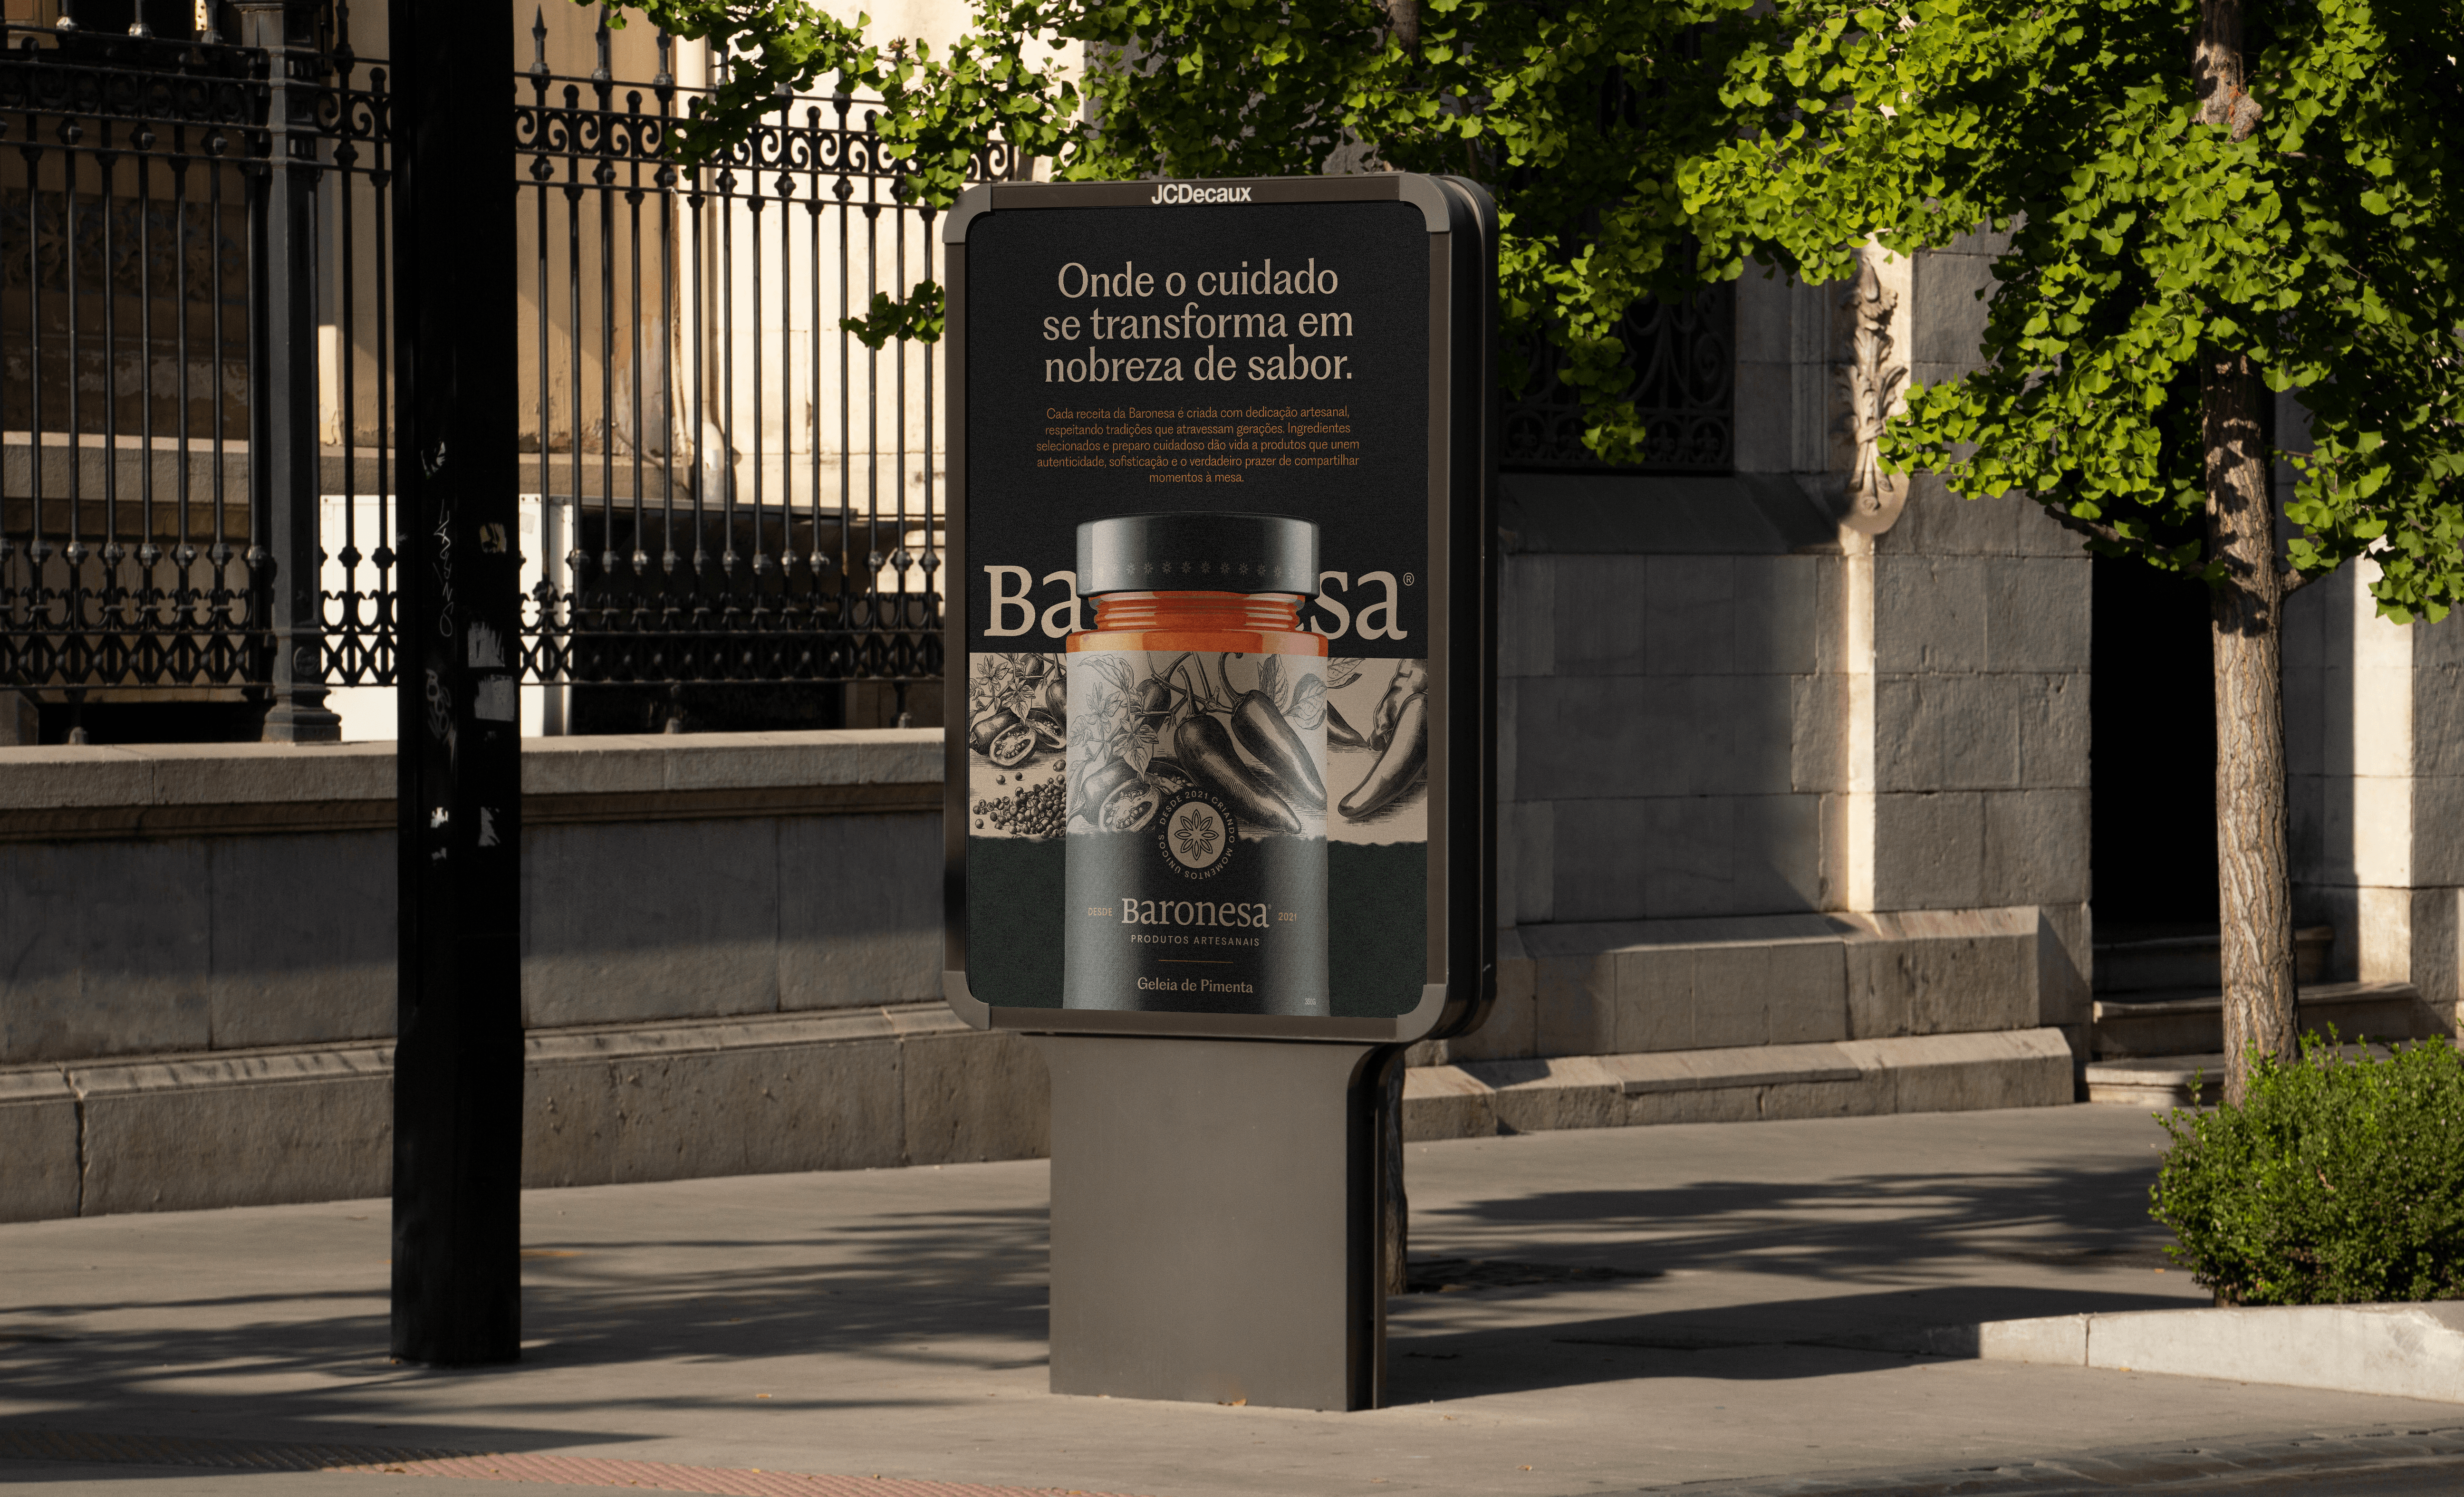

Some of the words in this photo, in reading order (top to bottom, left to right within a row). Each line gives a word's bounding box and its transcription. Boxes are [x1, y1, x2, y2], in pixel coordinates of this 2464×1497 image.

[1151, 183, 1252, 204] JCDecaux
[1058, 261, 1154, 298] Onde
[1165, 272, 1186, 297] o
[1197, 258, 1338, 296] cuidado
[1043, 316, 1080, 341] se
[1089, 302, 1289, 340] transforma
[1299, 312, 1353, 337] em
[1045, 346, 1184, 383] nobreza
[1194, 345, 1236, 381] de
[1248, 344, 1352, 381] sabor.
[1047, 408, 1074, 419] Cada
[1077, 409, 1111, 419] receita
[1114, 407, 1126, 419] da
[1129, 407, 1175, 419] Baronesa
[1177, 407, 1184, 418] é
[1186, 406, 1218, 418] criada
[1220, 410, 1243, 418] com
[1245, 406, 1298, 421] dedicação
[1300, 405, 1349, 418] artesanal,
[1045, 423, 1104, 438] respeitando
[1106, 423, 1152, 438] tradições
[1155, 426, 1174, 437] que
[1176, 424, 1233, 434] atravessam
[1236, 422, 1285, 437] gerações.
[1288, 422, 1351, 437] Ingredientes
[1036, 439, 1100, 451] selecionados
[1103, 442, 1109, 451] e
[1113, 442, 1151, 453] preparo
[1153, 439, 1205, 451] cuidadoso
[1207, 438, 1226, 450] dão
[1229, 438, 1249, 450] vida
[1261, 438, 1306, 453] produtos
[1309, 441, 1328, 452] que
[1331, 441, 1359, 450] unem
[1037, 455, 1107, 468] autenticidade,
[1109, 455, 1169, 470] sofisticação
[1171, 458, 1178, 467] e
[1180, 458, 1187, 466] o
[1189, 454, 1242, 466] verdadeiro
[1245, 458, 1277, 469] prazer
[1279, 454, 1291, 466] de
[1294, 454, 1359, 469] compartilhar
[1149, 472, 1203, 482] momentos
[1206, 471, 1212, 482] à
[1215, 474, 1244, 482] mesa.
[1184, 790, 1208, 799] 2021
[1159, 795, 1183, 826] DESDE
[1211, 796, 1235, 844] CRIANDO
[1184, 847, 1233, 879] MOMENTOS
[1087, 906, 1113, 917] DESDE
[1278, 911, 1298, 922] 2021
[1130, 934, 1189, 945] PRODUTOS
[1194, 936, 1259, 947] ARTESANAIS
[1137, 977, 1178, 990] Geleia
[1181, 978, 1197, 991] de
[1201, 979, 1253, 993] Pimenta
